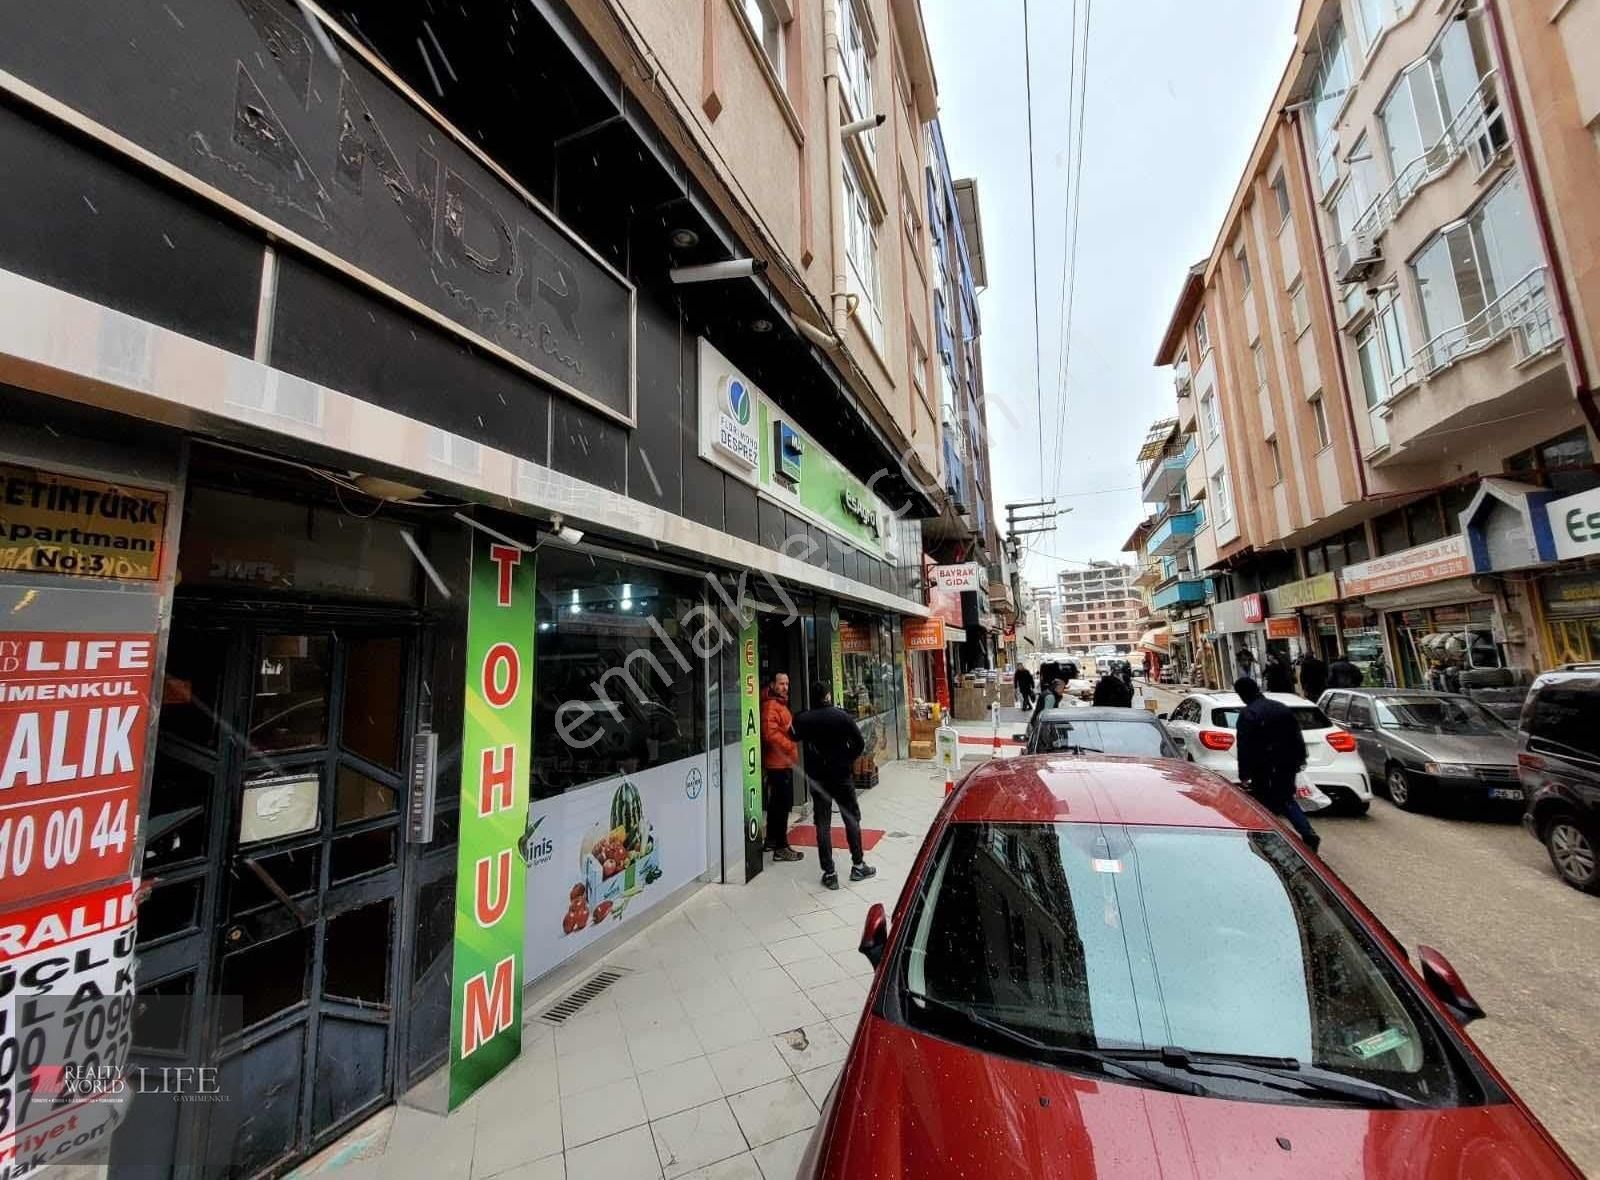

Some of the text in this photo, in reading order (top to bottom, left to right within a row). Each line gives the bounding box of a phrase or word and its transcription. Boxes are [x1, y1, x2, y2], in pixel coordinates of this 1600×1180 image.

[721, 429, 758, 466] DESPREZ
[0, 474, 157, 524] ETİNTÜRK
[939, 568, 974, 578] BAYRAK
[945, 578, 969, 586] GIDA
[26, 640, 150, 671] LIFE
[0, 706, 139, 789] ALIK
[460, 543, 522, 1060] TOHUM
[44, 807, 83, 870] 00
[90, 799, 129, 857] 44
[63, 990, 132, 1060] 7099
